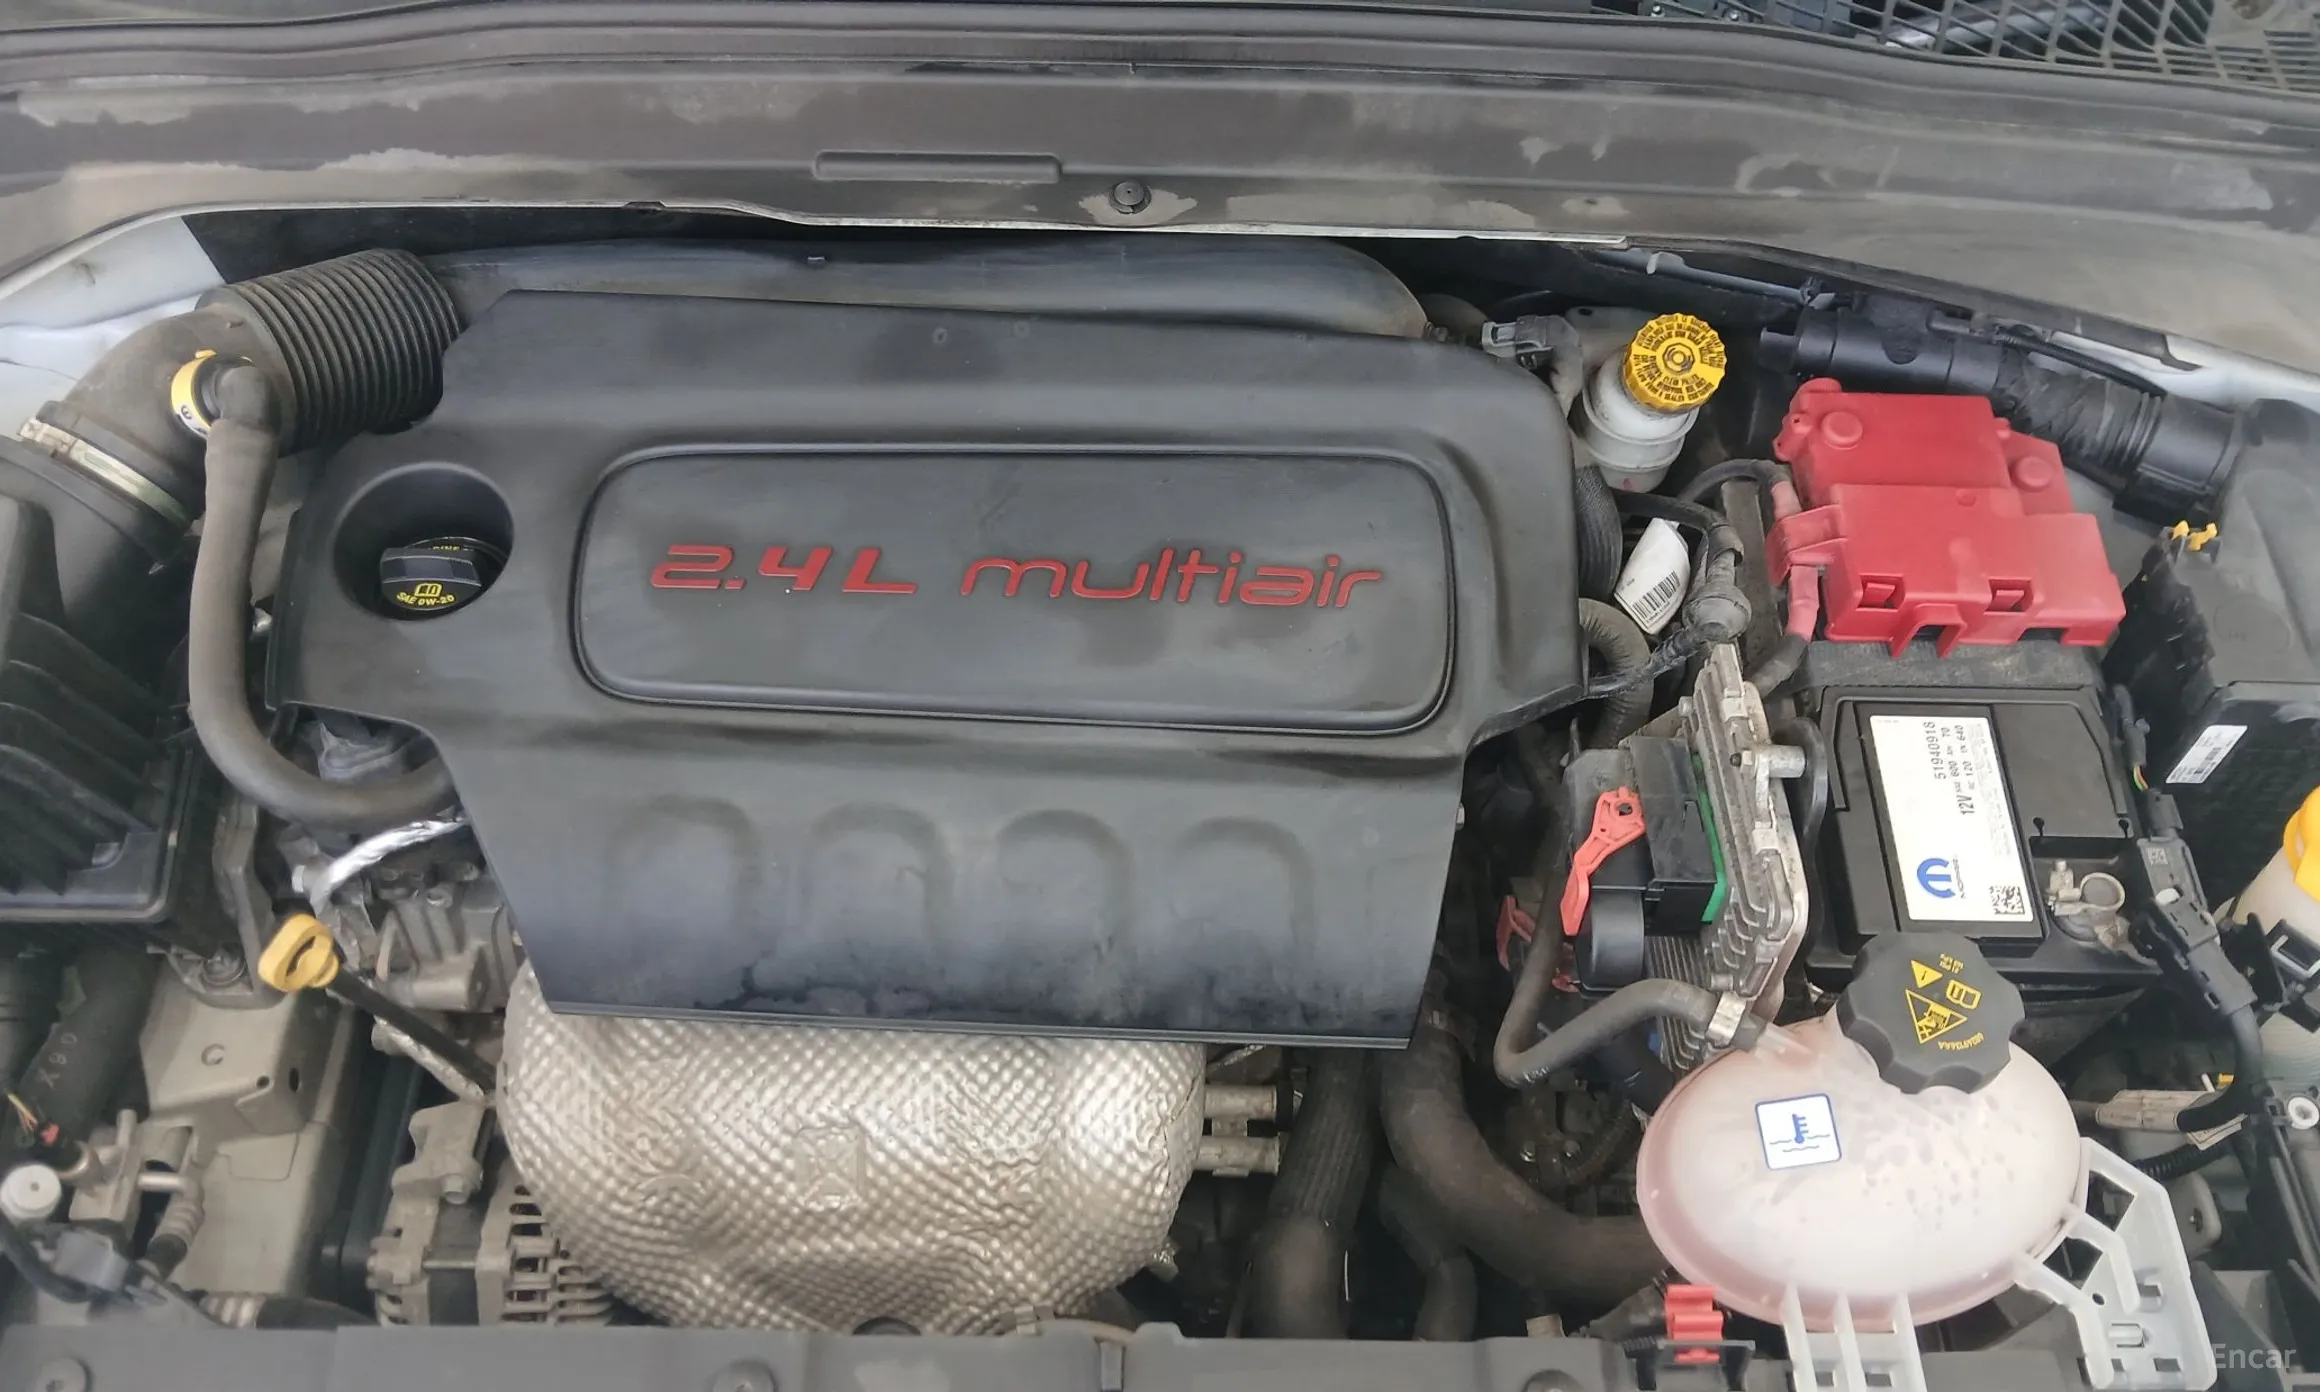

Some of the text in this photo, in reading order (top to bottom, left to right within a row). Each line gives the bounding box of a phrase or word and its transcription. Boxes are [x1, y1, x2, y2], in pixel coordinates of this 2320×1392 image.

[961, 547, 1382, 609] multiair
[396, 591, 455, 606] SAE 0W-20
[1956, 793, 1975, 815] 12V
